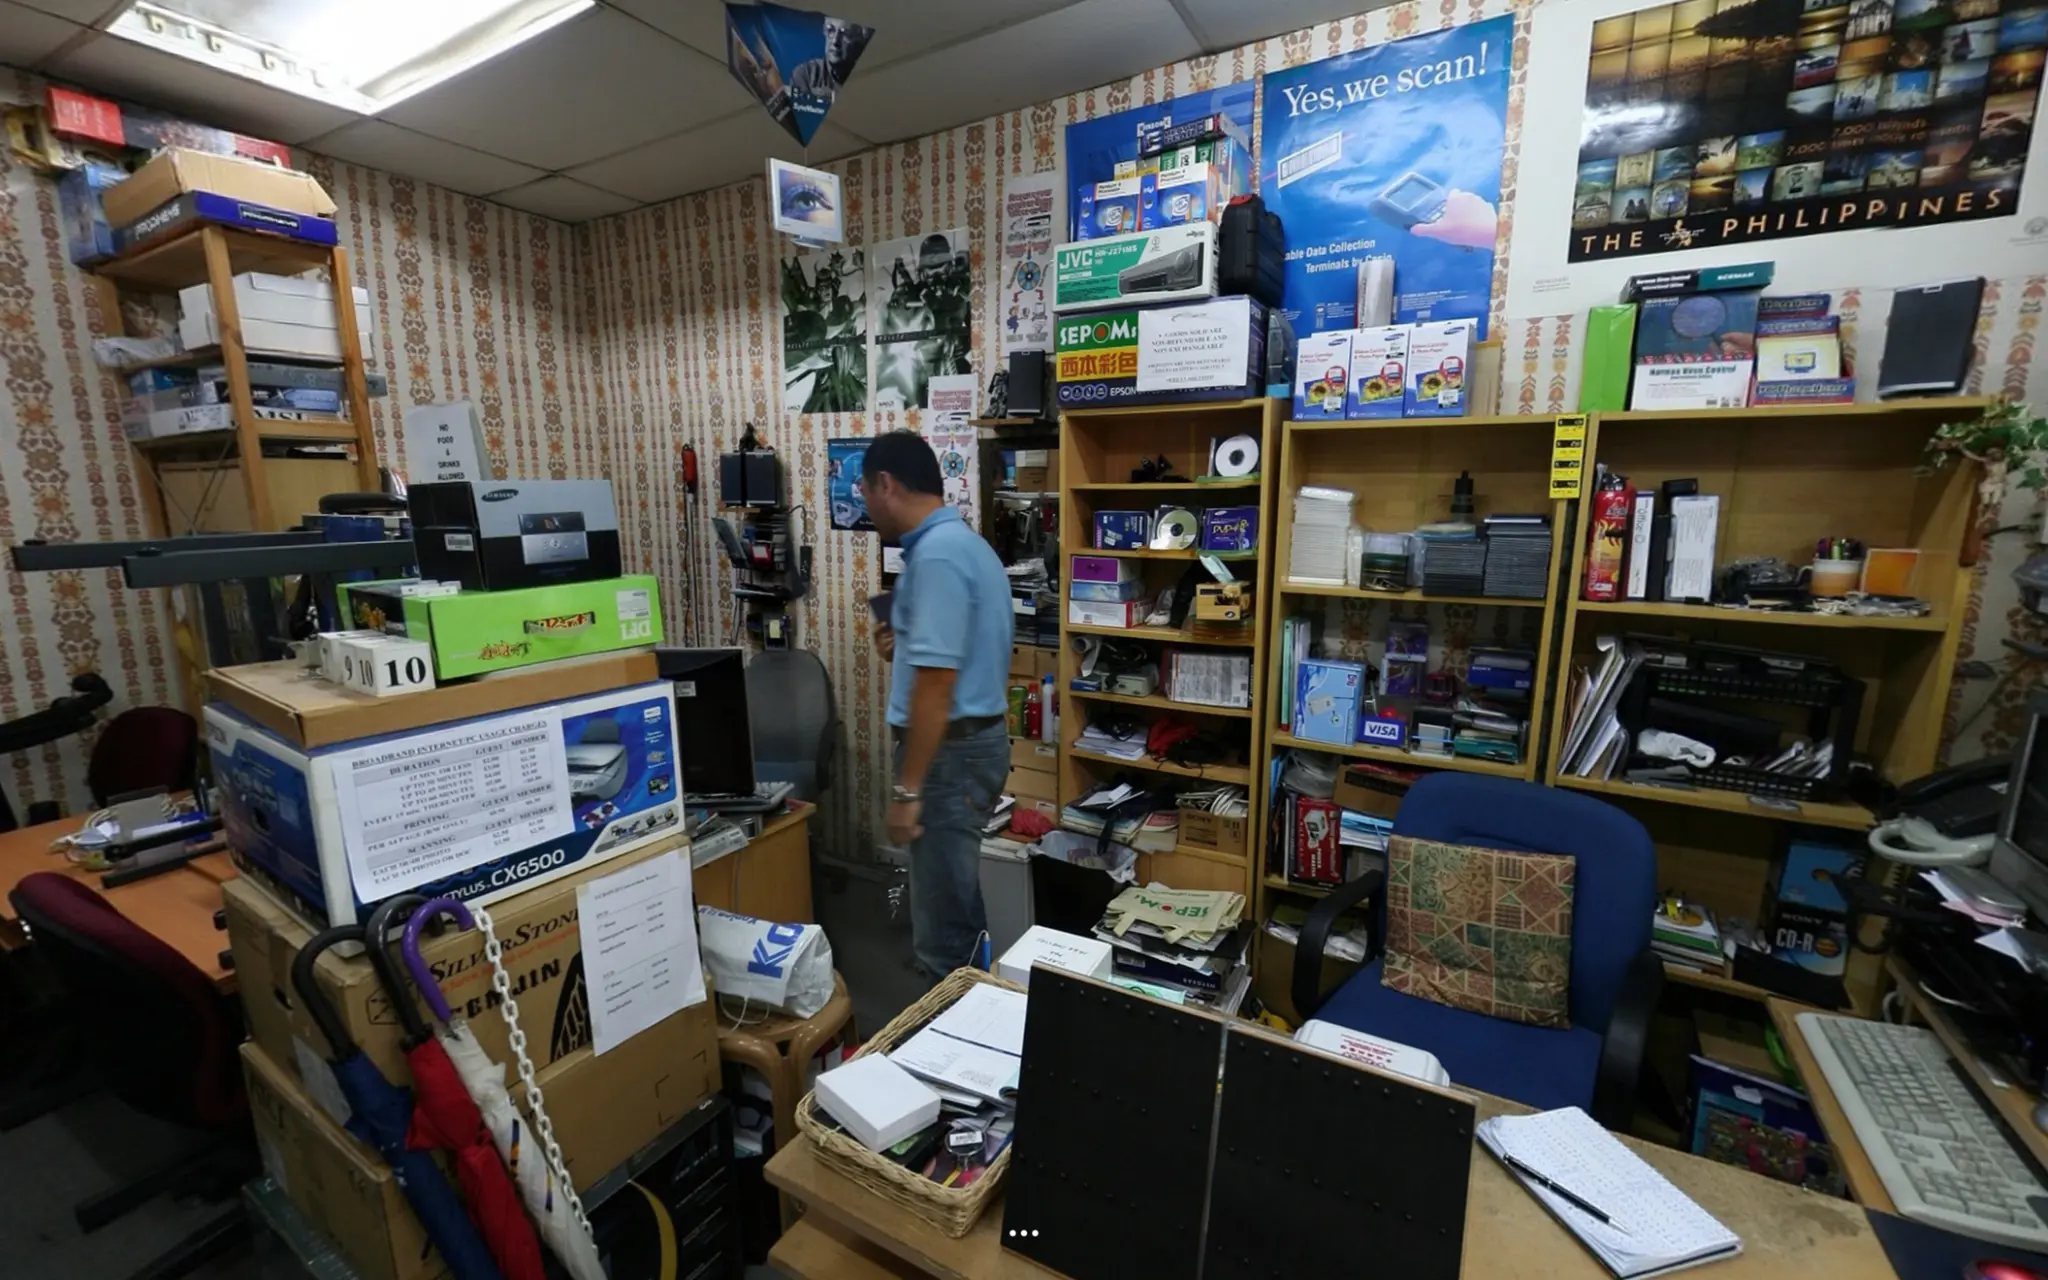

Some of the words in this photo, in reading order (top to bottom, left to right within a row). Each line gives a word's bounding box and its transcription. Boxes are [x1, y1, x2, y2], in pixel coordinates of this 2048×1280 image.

[1344, 74, 1389, 103] we
[1397, 41, 1488, 93] scan!
[1582, 230, 1644, 254] THE
[1722, 188, 2003, 238] PHILIPPINES
[1059, 249, 1093, 269] JVC
[1285, 248, 1304, 261] able
[1306, 245, 1327, 258] Data
[1330, 238, 1376, 254] Collection
[1305, 257, 1350, 274] Terminals
[1061, 351, 1137, 378] 西本彩色
[359, 660, 374, 688] 10
[384, 656, 426, 688] 10
[351, 747, 415, 770] BROADBAND
[507, 718, 547, 735] CHARGES
[1368, 725, 1397, 737] VISA
[388, 755, 441, 776] DURATION
[510, 732, 546, 747] MEMBER
[403, 810, 450, 831] PRINTING
[516, 782, 551, 799] MEMBER
[406, 833, 456, 855] SCANNING
[518, 803, 554, 821] MEMBER
[491, 848, 566, 887] CX6500
[430, 908, 578, 984] SILVRSTON
[1775, 927, 1814, 954] CD-R
[449, 956, 562, 1020] ENJIN
